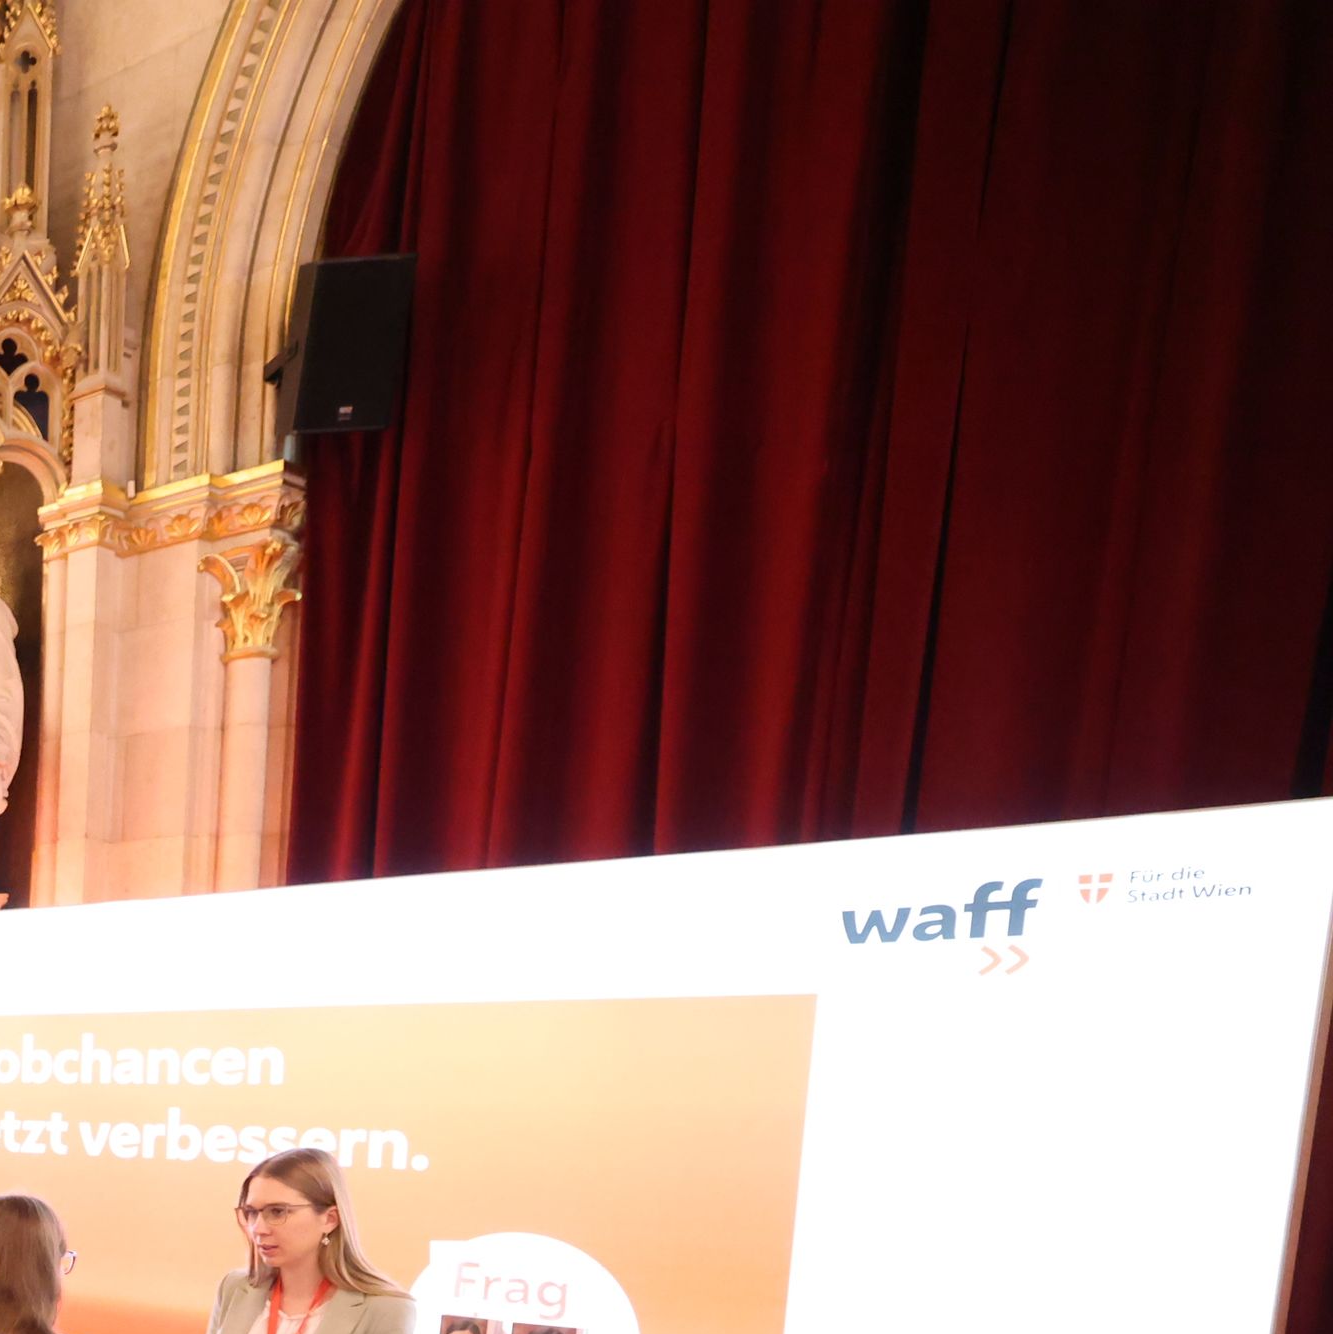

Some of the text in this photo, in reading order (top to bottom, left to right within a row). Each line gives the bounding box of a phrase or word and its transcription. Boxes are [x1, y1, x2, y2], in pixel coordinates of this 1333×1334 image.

[1127, 882, 1252, 903] Stadt Wien
[1171, 866, 1206, 882] die
[841, 877, 1044, 945] waff
[78, 1106, 430, 1172] verbessern.
[454, 1261, 569, 1321] Frag
